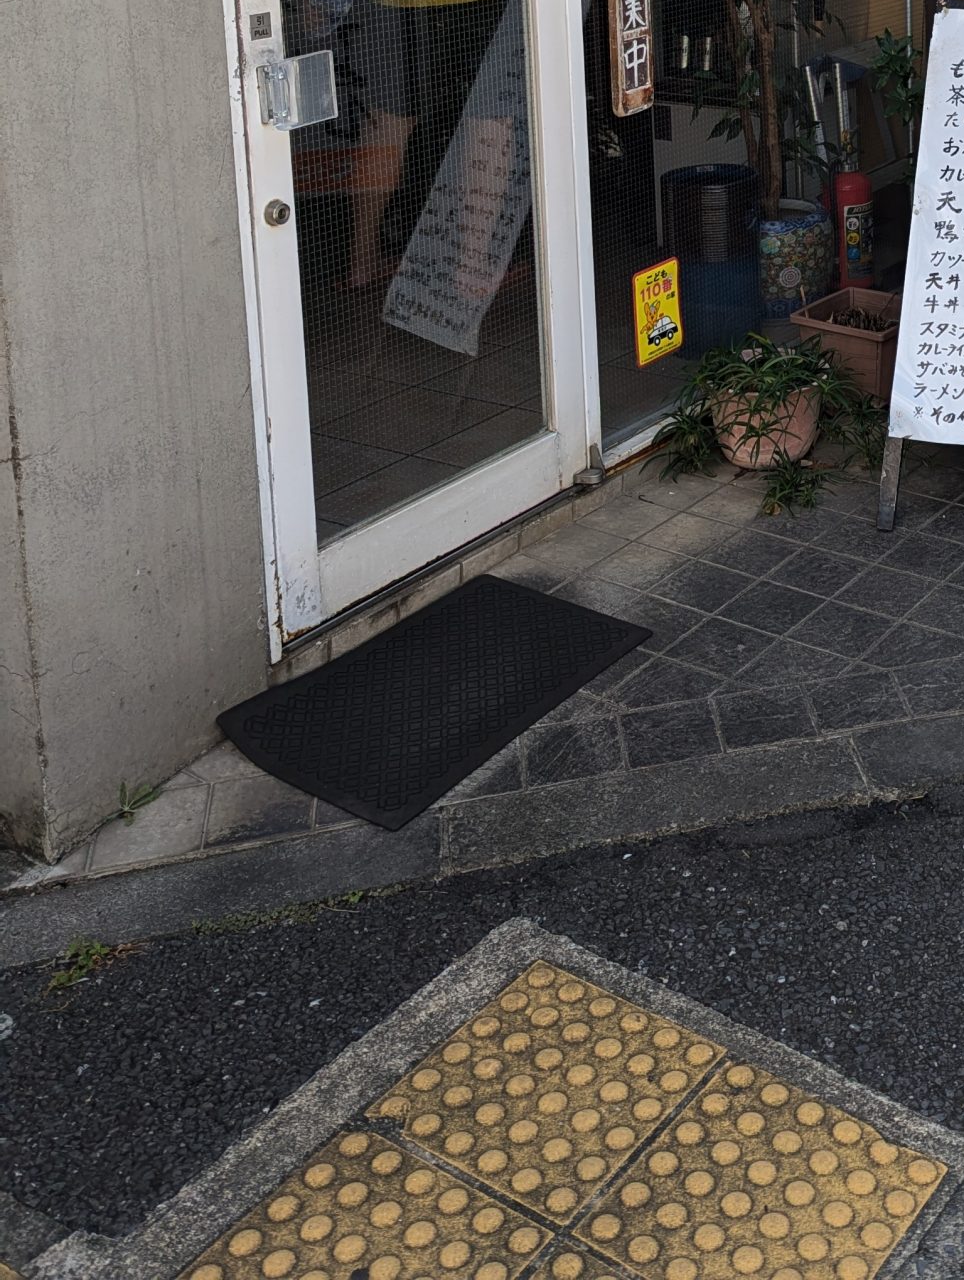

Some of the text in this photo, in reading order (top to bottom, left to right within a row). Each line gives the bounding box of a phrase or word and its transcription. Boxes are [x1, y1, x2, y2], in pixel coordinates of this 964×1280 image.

[254, 29, 270, 37] PULL
[646, 269, 668, 285] こども
[640, 278, 672, 302] 110番
